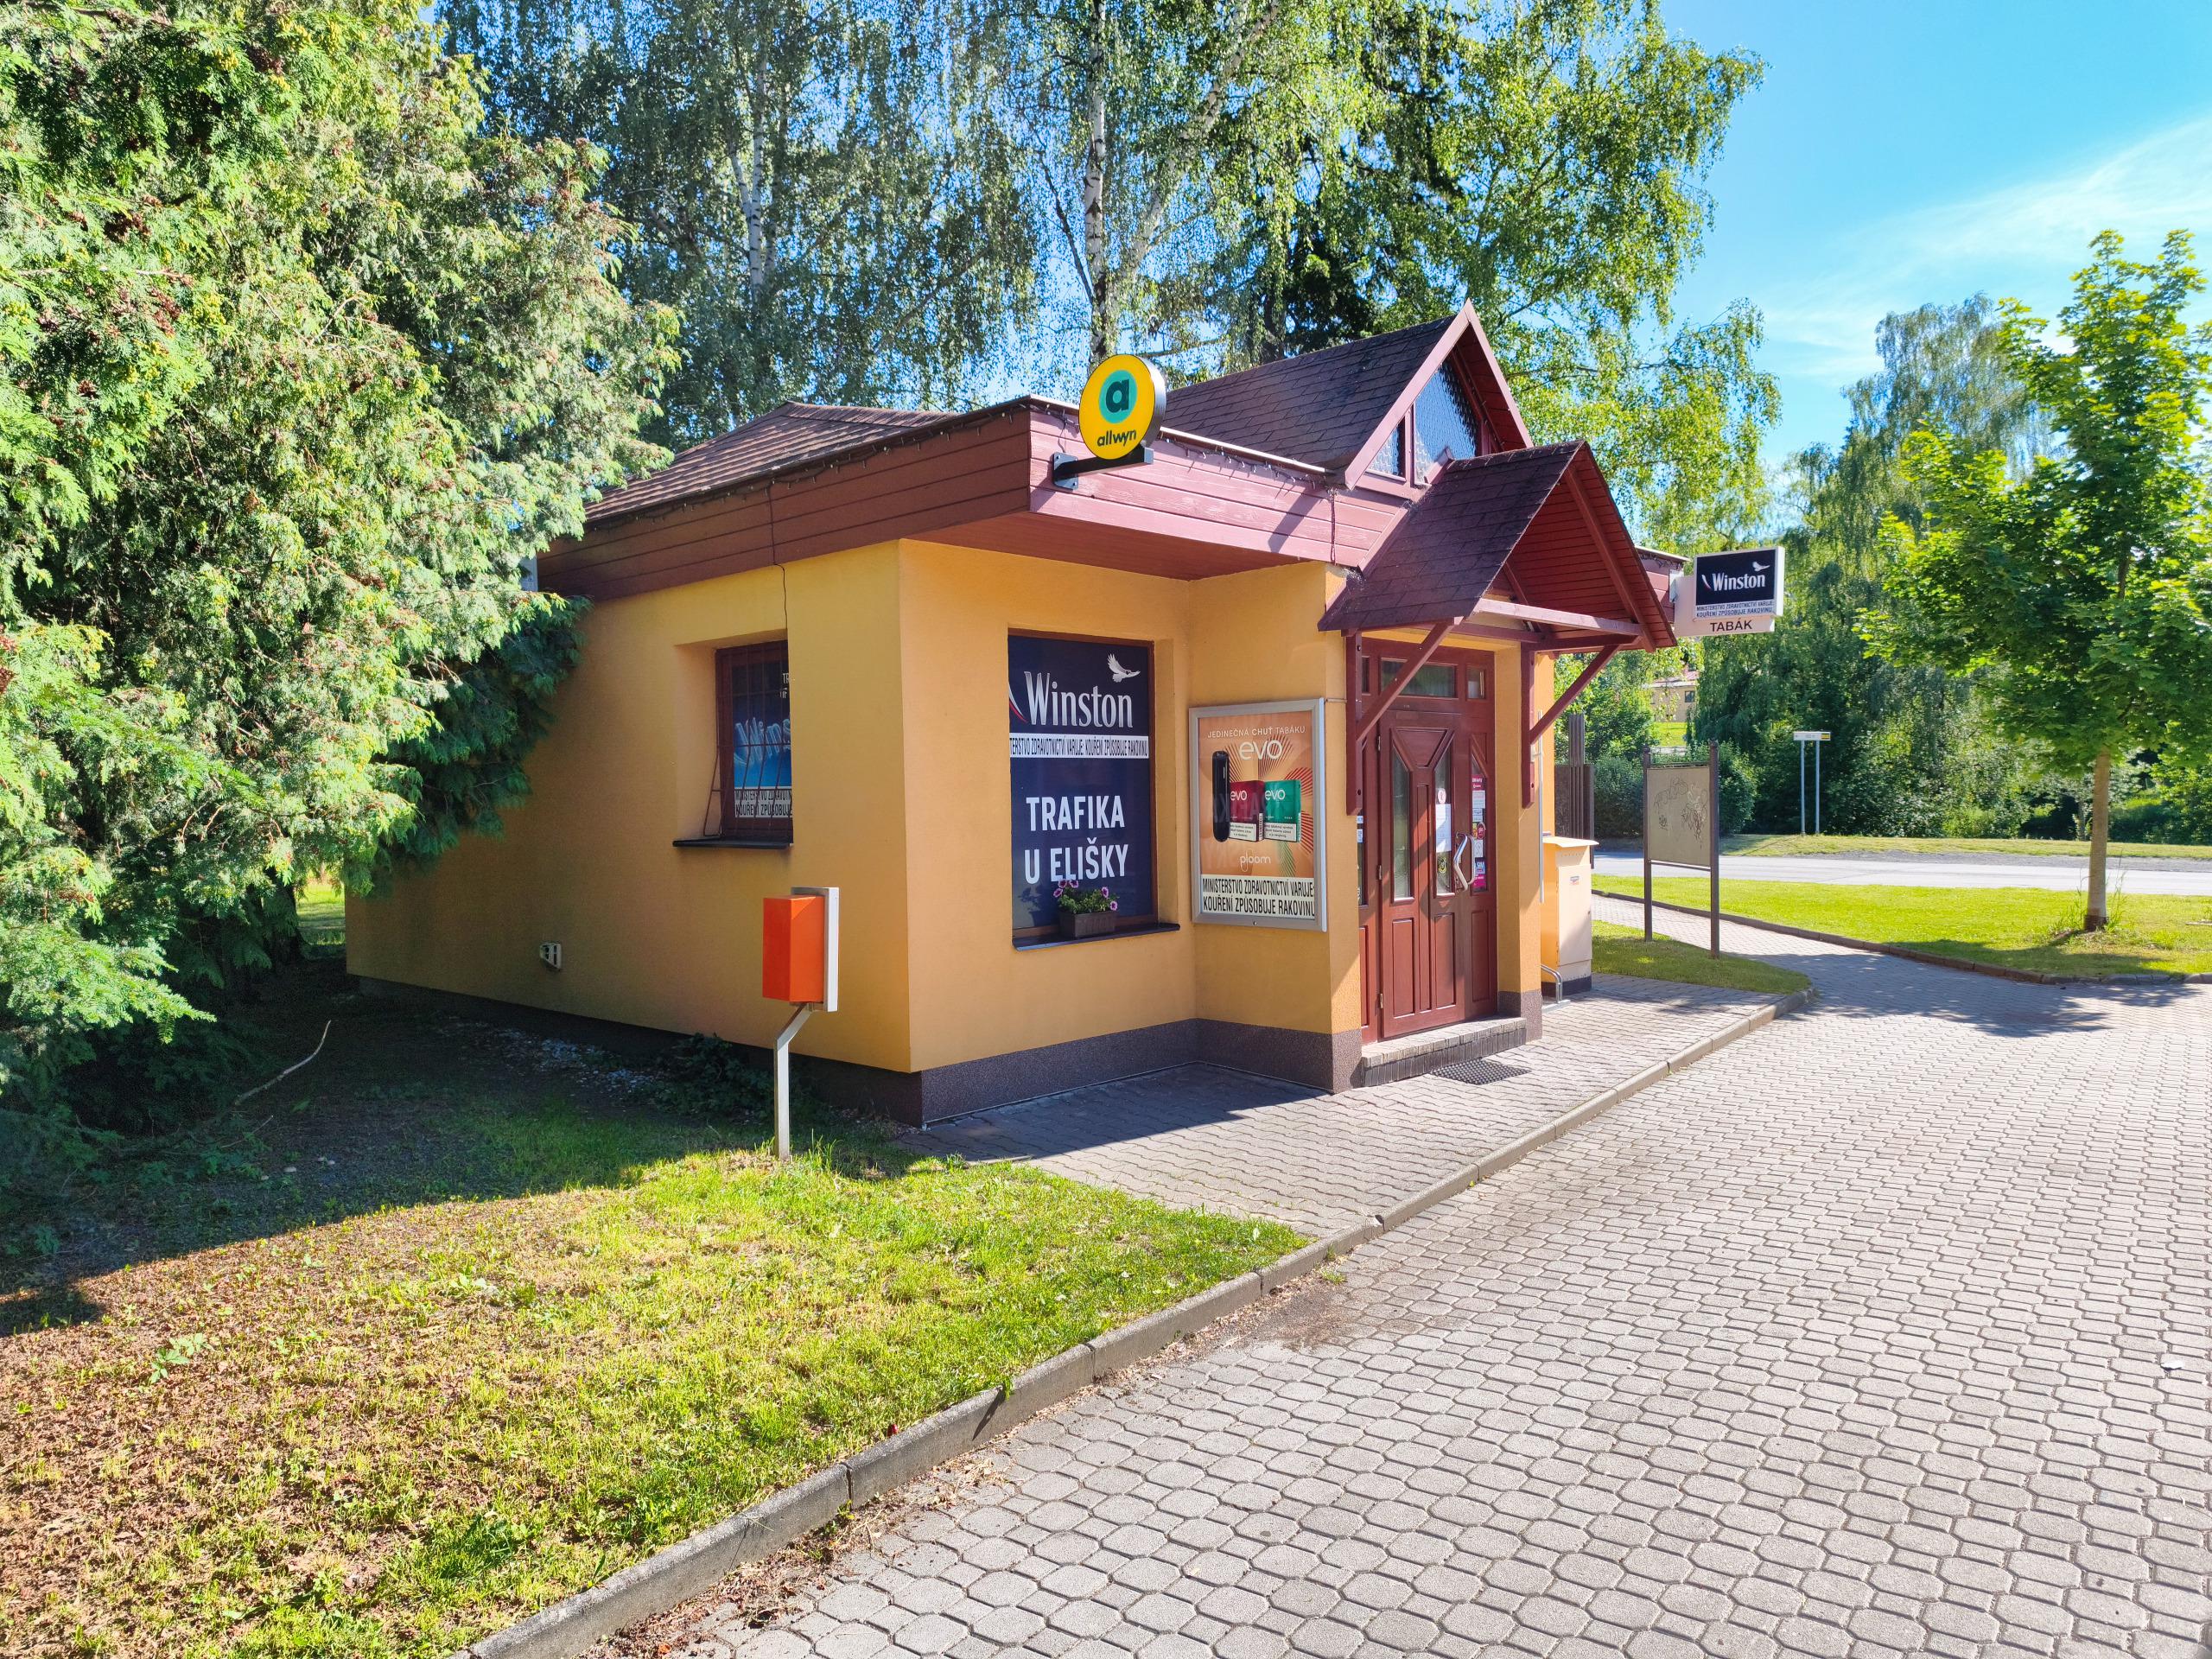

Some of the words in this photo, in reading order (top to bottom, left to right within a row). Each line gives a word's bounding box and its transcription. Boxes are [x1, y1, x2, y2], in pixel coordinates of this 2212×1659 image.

[1105, 379, 1129, 413] a
[1096, 429, 1137, 447] allwyn
[1712, 572, 1765, 592] Winston
[1710, 617, 1752, 632] TABÁK
[1024, 671, 1133, 728] Winston
[1208, 728, 1249, 738] JEDINEČNÁ
[1251, 727, 1273, 735] CHUŤ
[1275, 725, 1306, 734] TABÁKU
[1032, 735, 1065, 755] ZDRAVOTNICTVÍ
[1085, 736, 1103, 756] KOUŘENÍ
[1104, 737, 1127, 756] ZPŮSOBUJE
[1128, 740, 1147, 756] RAKOVINU
[1239, 740, 1282, 760] evo
[1230, 790, 1247, 801] evo
[1264, 789, 1285, 800] evo
[1026, 795, 1125, 831] TRAFIKA
[1025, 849, 1039, 884] U
[1050, 837, 1128, 882] ELIŠKY
[1240, 852, 1271, 872] ploom
[1203, 878, 1243, 894] MINISTERSTVO
[1244, 879, 1288, 896] ZDRAVOTNICTVÍ
[1203, 894, 1233, 912] KOUŘENÍ
[1236, 897, 1275, 914] ZPŮSOBUJE
